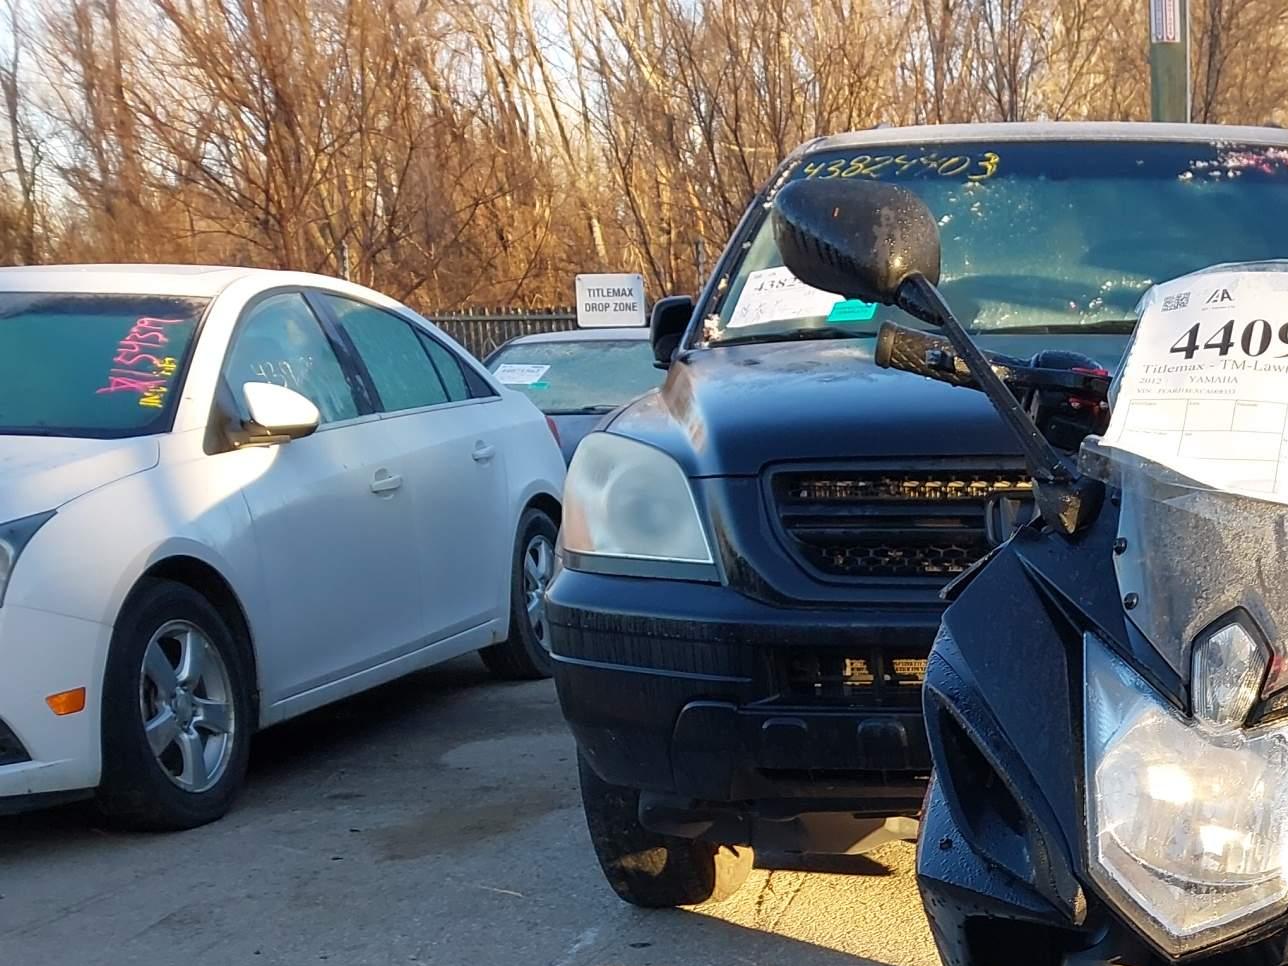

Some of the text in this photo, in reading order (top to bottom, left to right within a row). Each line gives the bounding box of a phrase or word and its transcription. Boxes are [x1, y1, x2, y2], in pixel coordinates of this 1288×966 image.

[587, 288, 634, 298] TITLEMAX
[584, 302, 638, 312] DROP ZONE
[1143, 362, 1205, 375] Titlemax
[1189, 375, 1239, 384] YAMAHA
